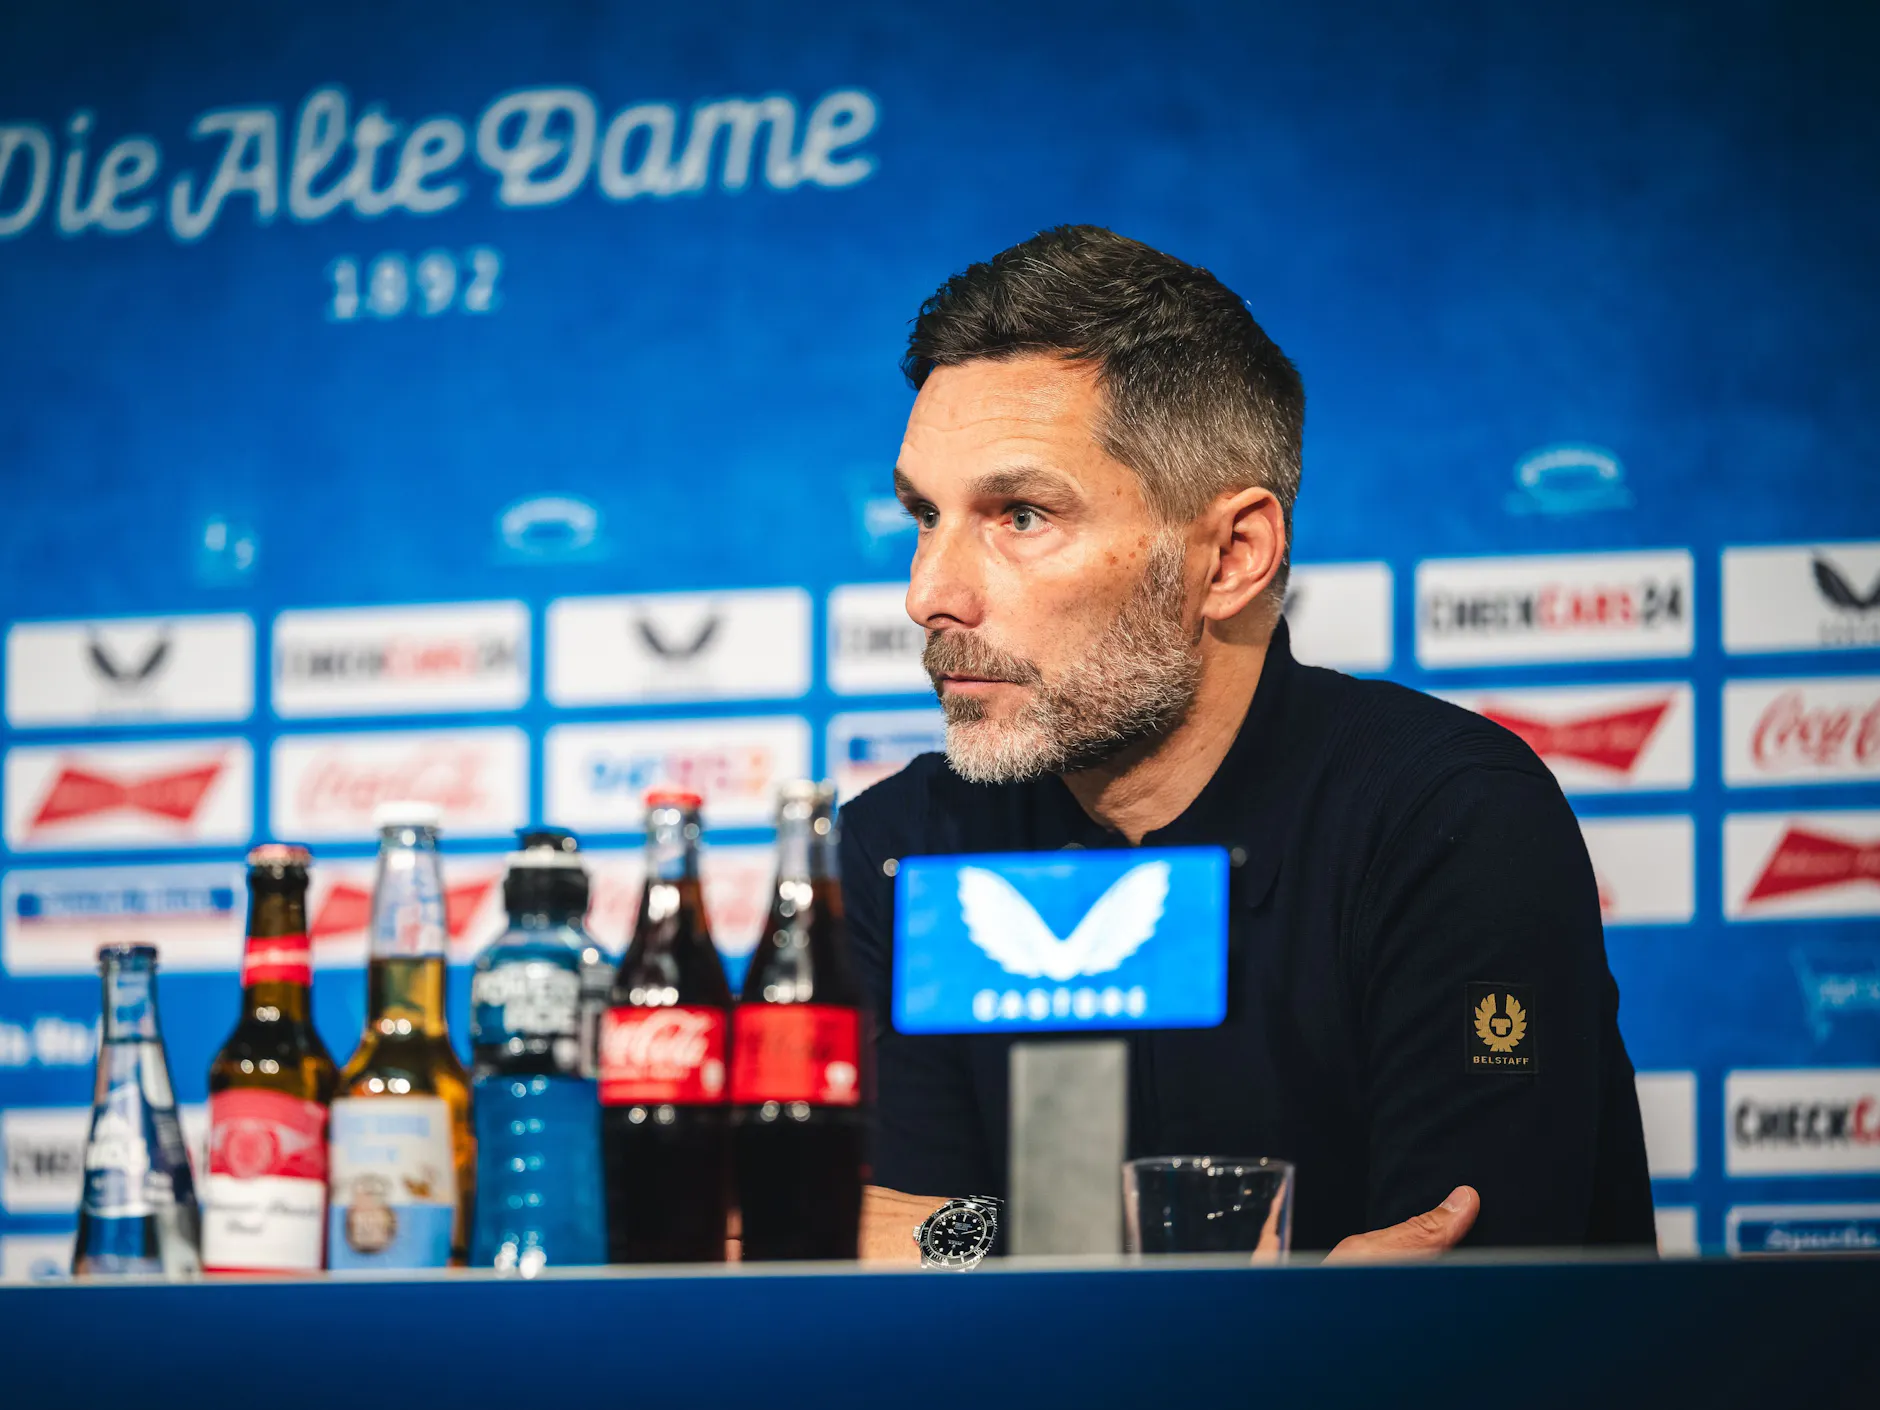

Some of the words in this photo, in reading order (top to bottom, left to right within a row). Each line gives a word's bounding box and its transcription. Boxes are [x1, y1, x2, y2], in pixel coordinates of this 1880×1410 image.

[0, 108, 158, 237] Die
[170, 87, 467, 241] Alte
[476, 87, 878, 203] Dame
[326, 247, 502, 320] 1892
[1425, 579, 1684, 634] CHECKCARS24
[1473, 1055, 1529, 1065] BELSTAFF
[1735, 1096, 1880, 1150] CHECKC
